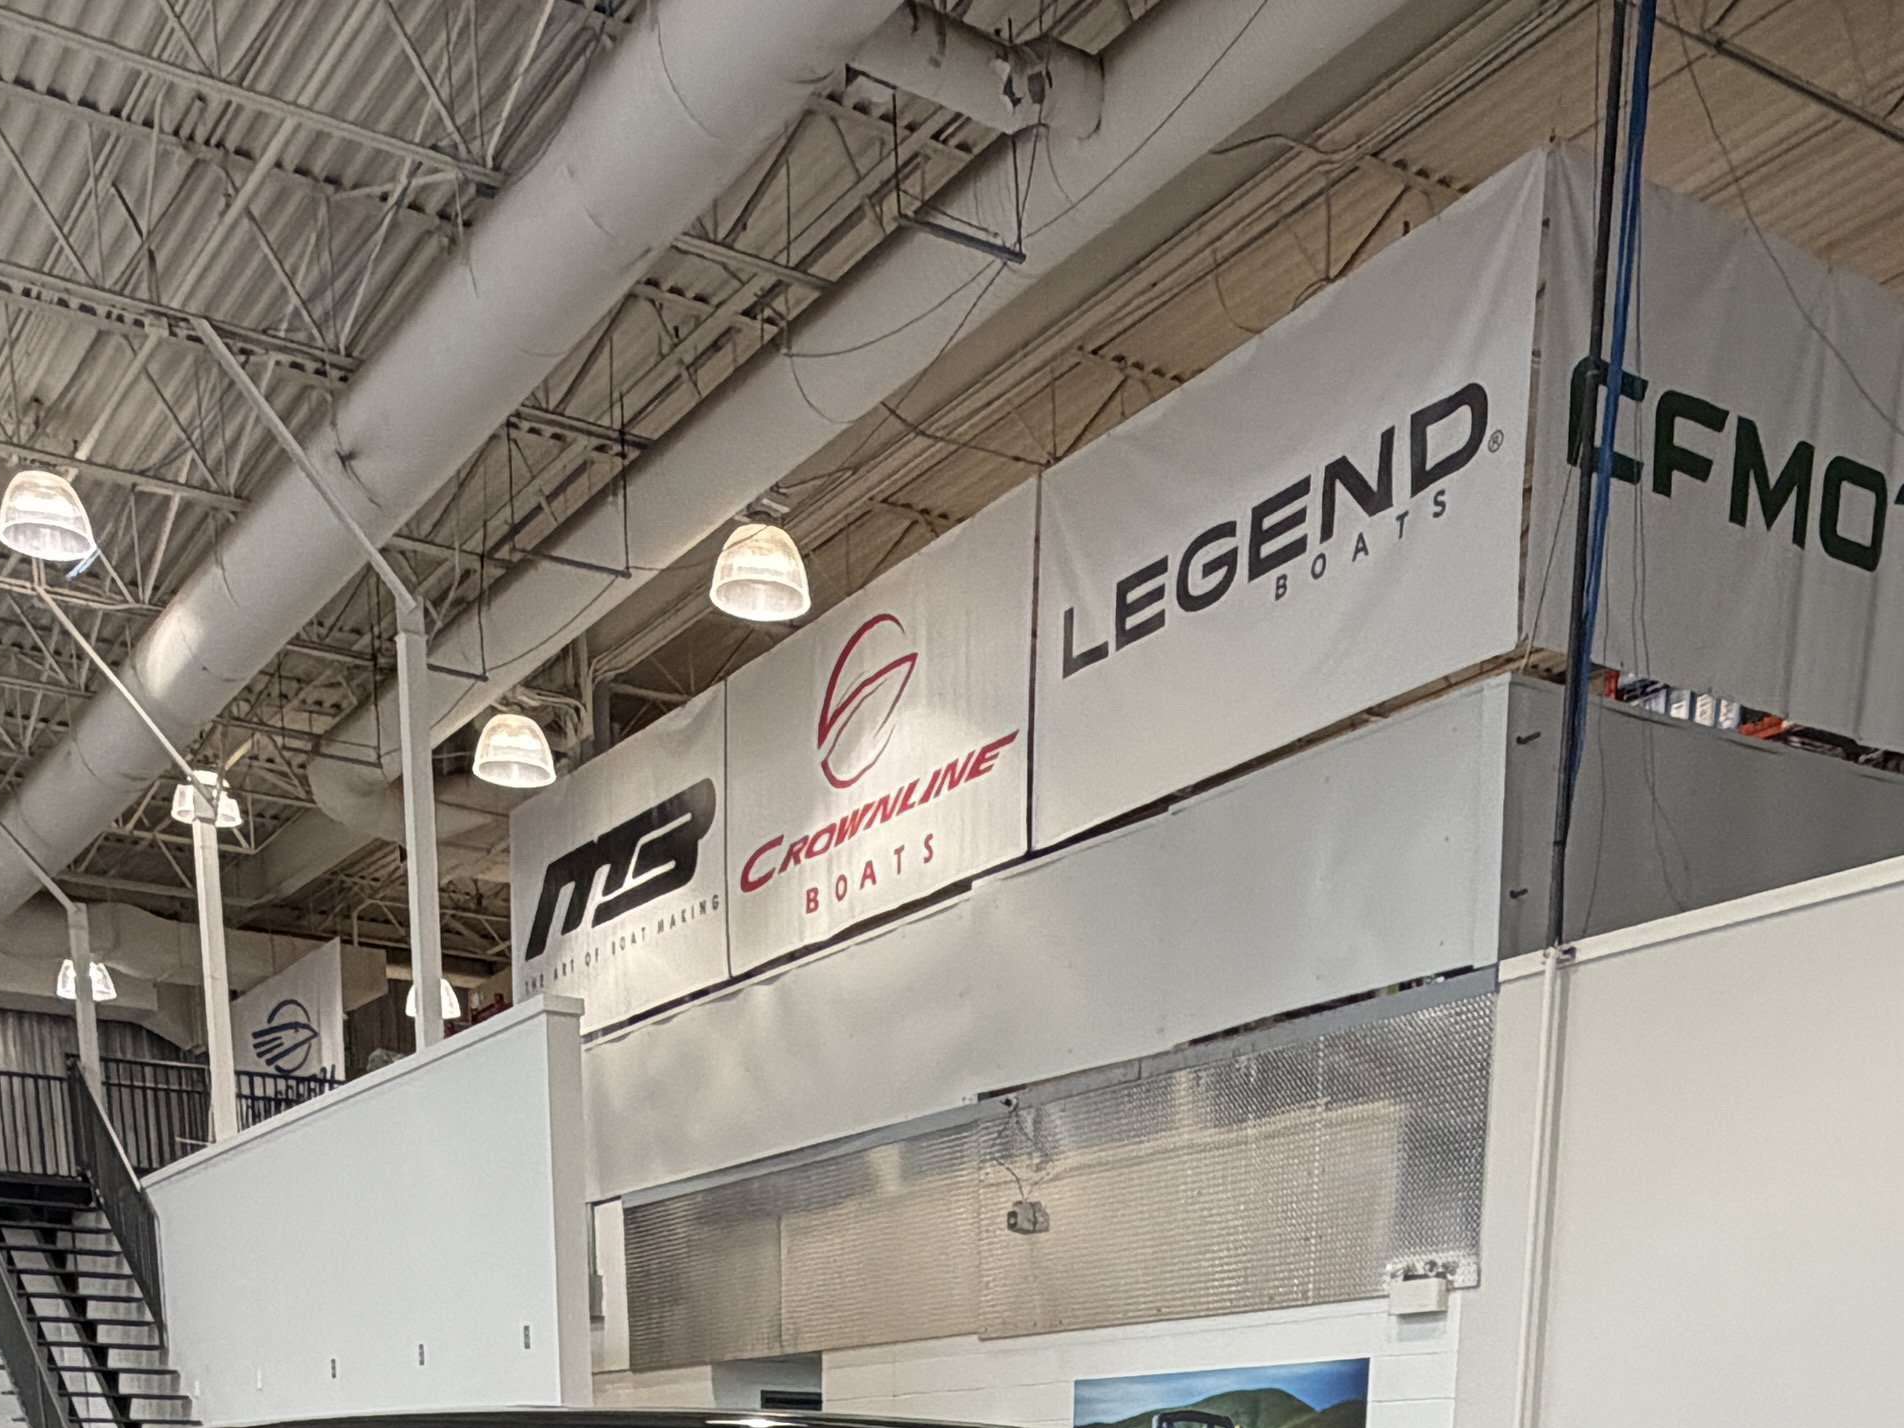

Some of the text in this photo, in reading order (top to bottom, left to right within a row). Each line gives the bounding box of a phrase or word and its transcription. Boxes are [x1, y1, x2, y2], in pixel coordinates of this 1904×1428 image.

[1062, 382, 1489, 679] LEGEND
[1274, 489, 1447, 601] BOATS
[805, 833, 934, 914] BOATS
[525, 894, 720, 996] THE ART OF BOAT MAKING
